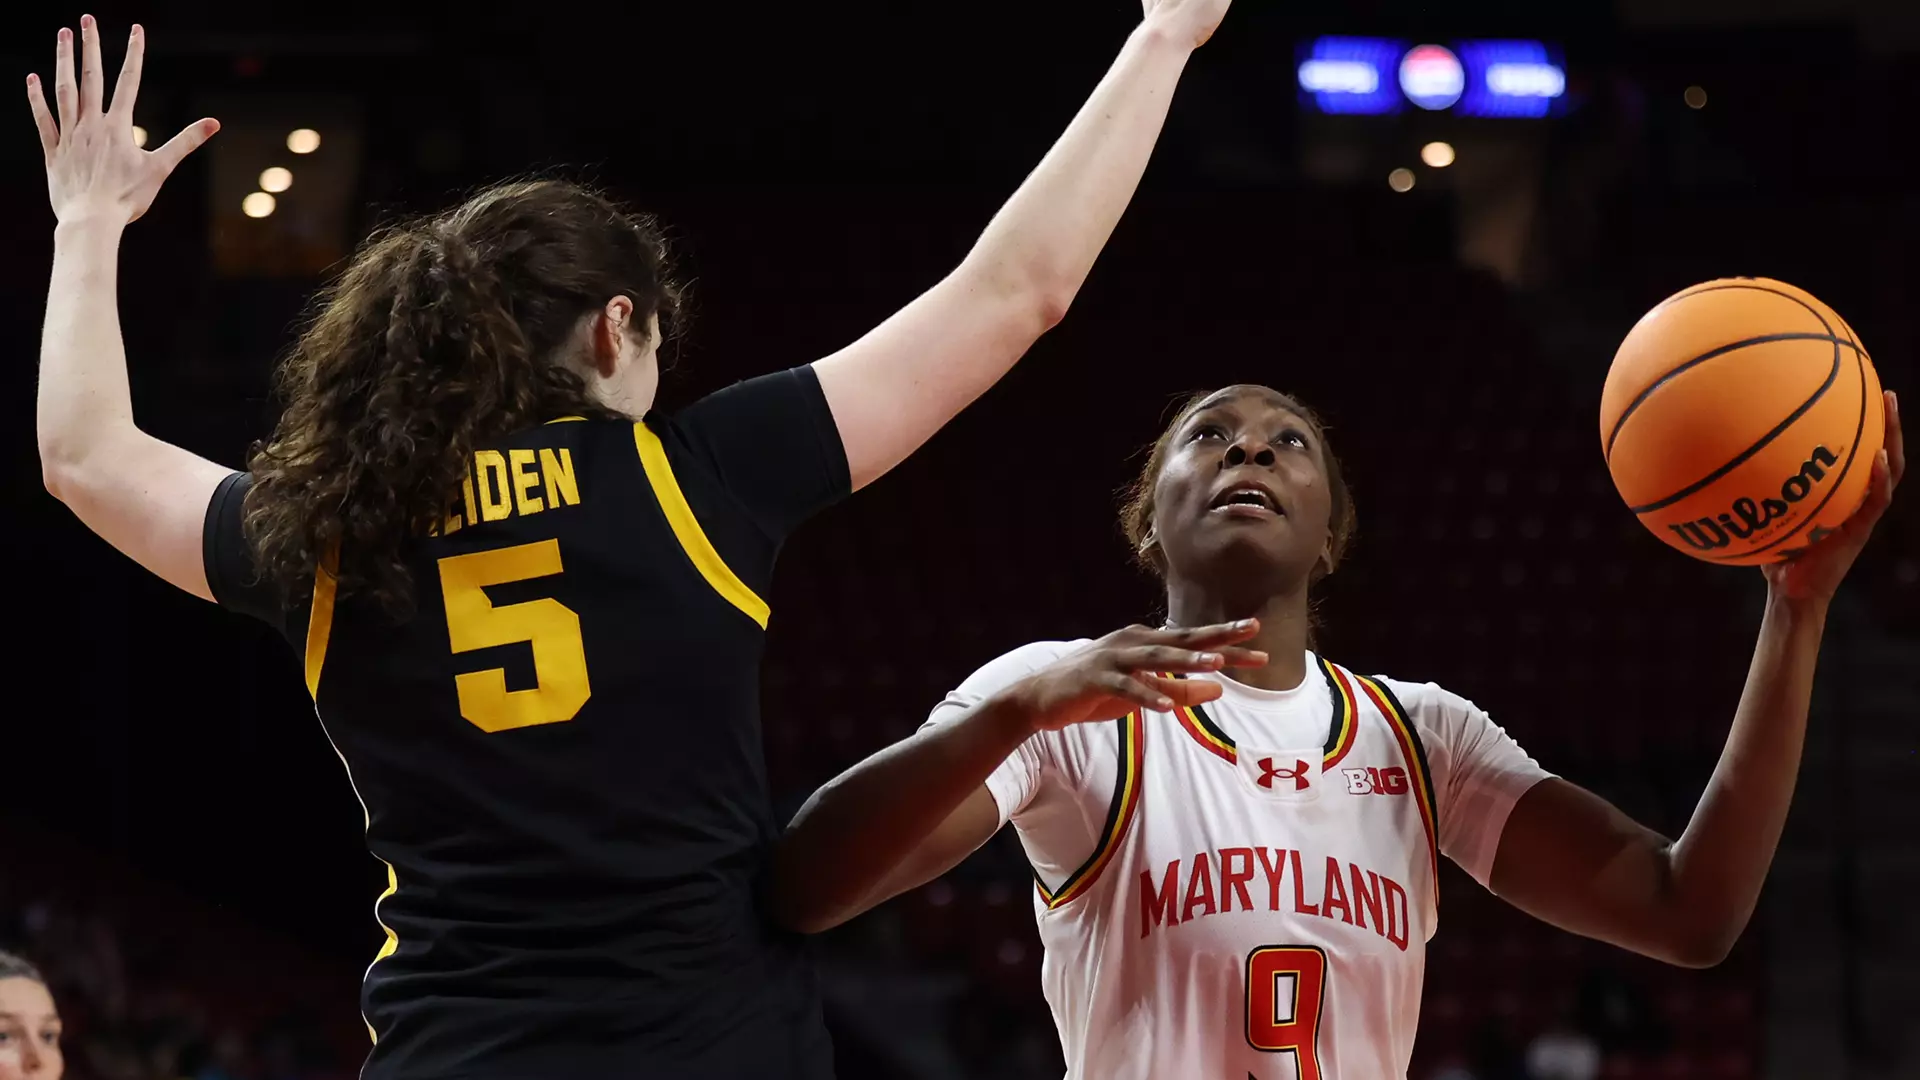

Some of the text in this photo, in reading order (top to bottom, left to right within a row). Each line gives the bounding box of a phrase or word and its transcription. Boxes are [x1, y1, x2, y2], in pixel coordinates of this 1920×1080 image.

[428, 447, 581, 538] IDEN
[1669, 444, 1839, 551] Wilson
[437, 538, 592, 733] 5
[1139, 846, 1409, 952] MARYLAND
[1245, 944, 1327, 1080] 9
